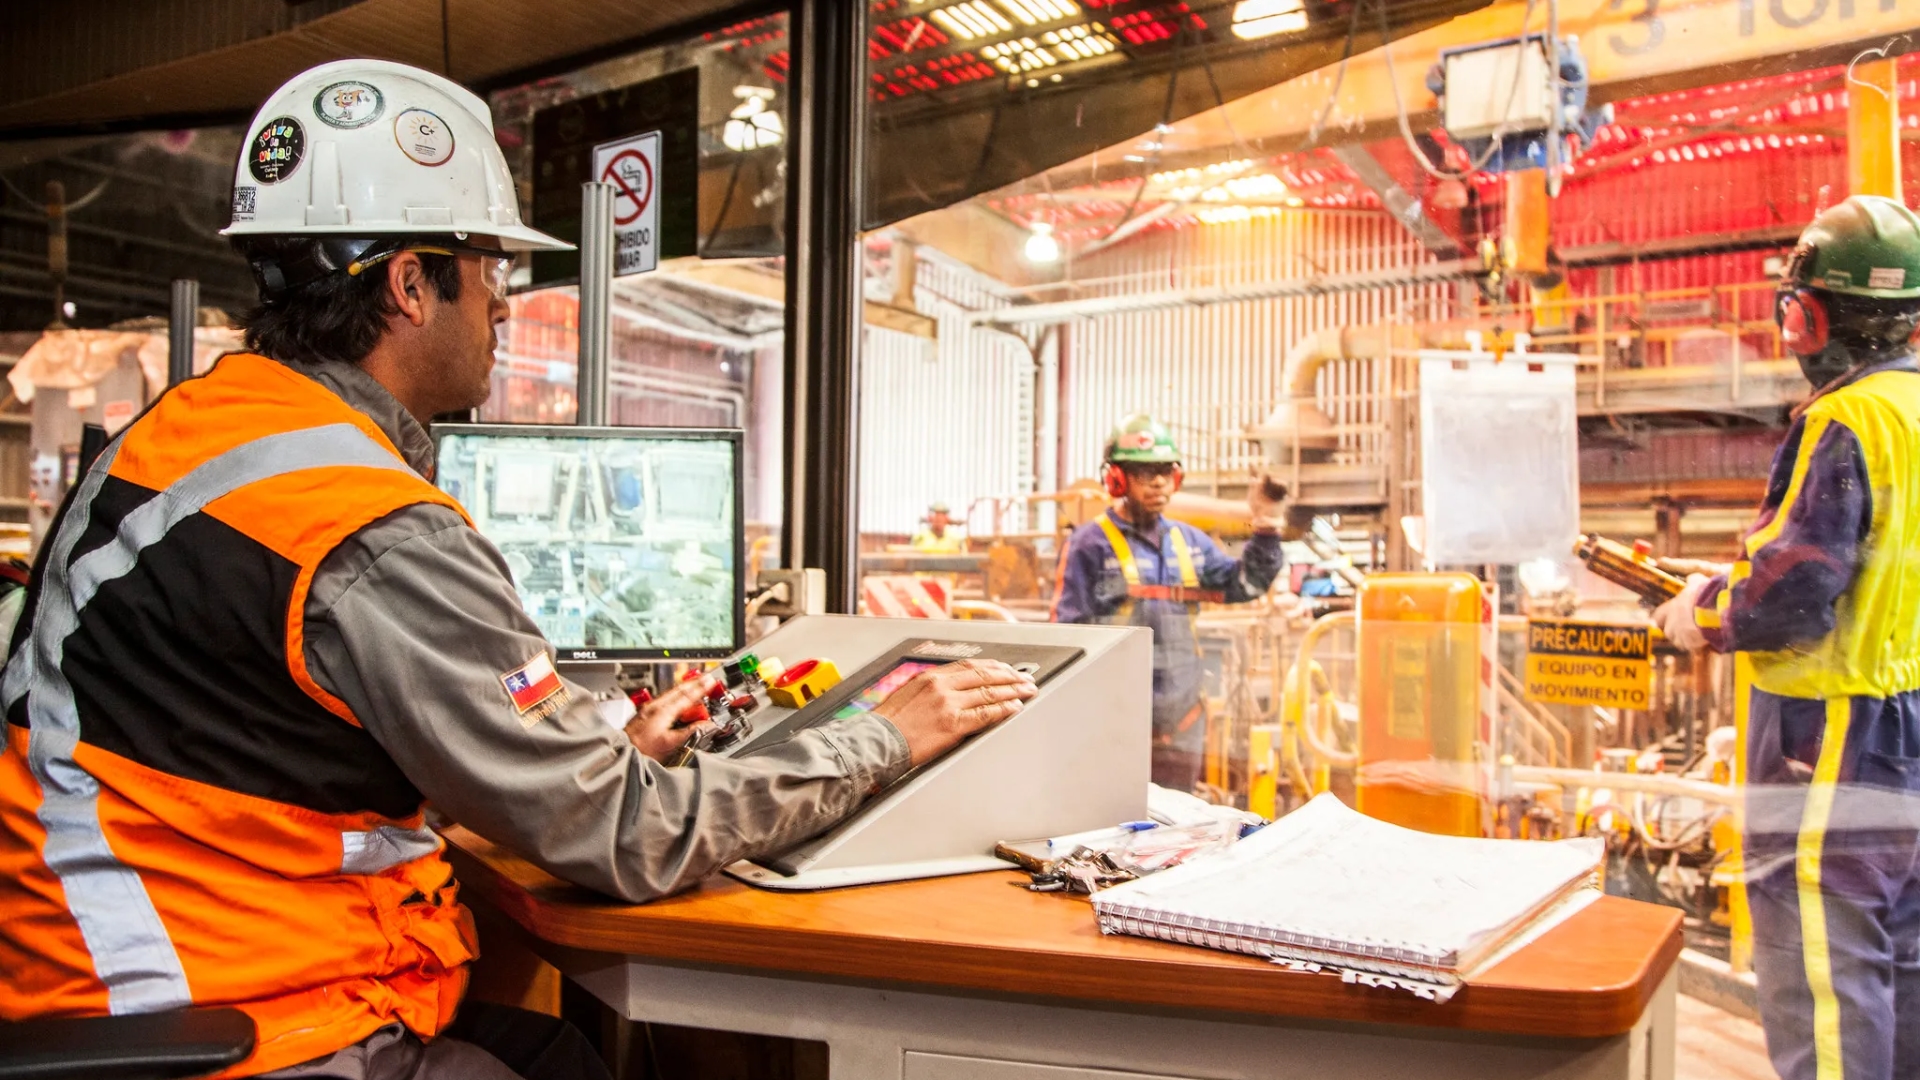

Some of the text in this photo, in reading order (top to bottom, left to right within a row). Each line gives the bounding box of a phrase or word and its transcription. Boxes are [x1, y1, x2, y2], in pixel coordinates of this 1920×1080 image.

[1609, 0, 1665, 56] 3
[615, 227, 650, 249] HIBIDO
[615, 250, 641, 270] MAR
[573, 651, 597, 659] DELL
[1538, 660, 1637, 679] EQUIPO EN
[1530, 683, 1645, 704] MOVIMIENTO
